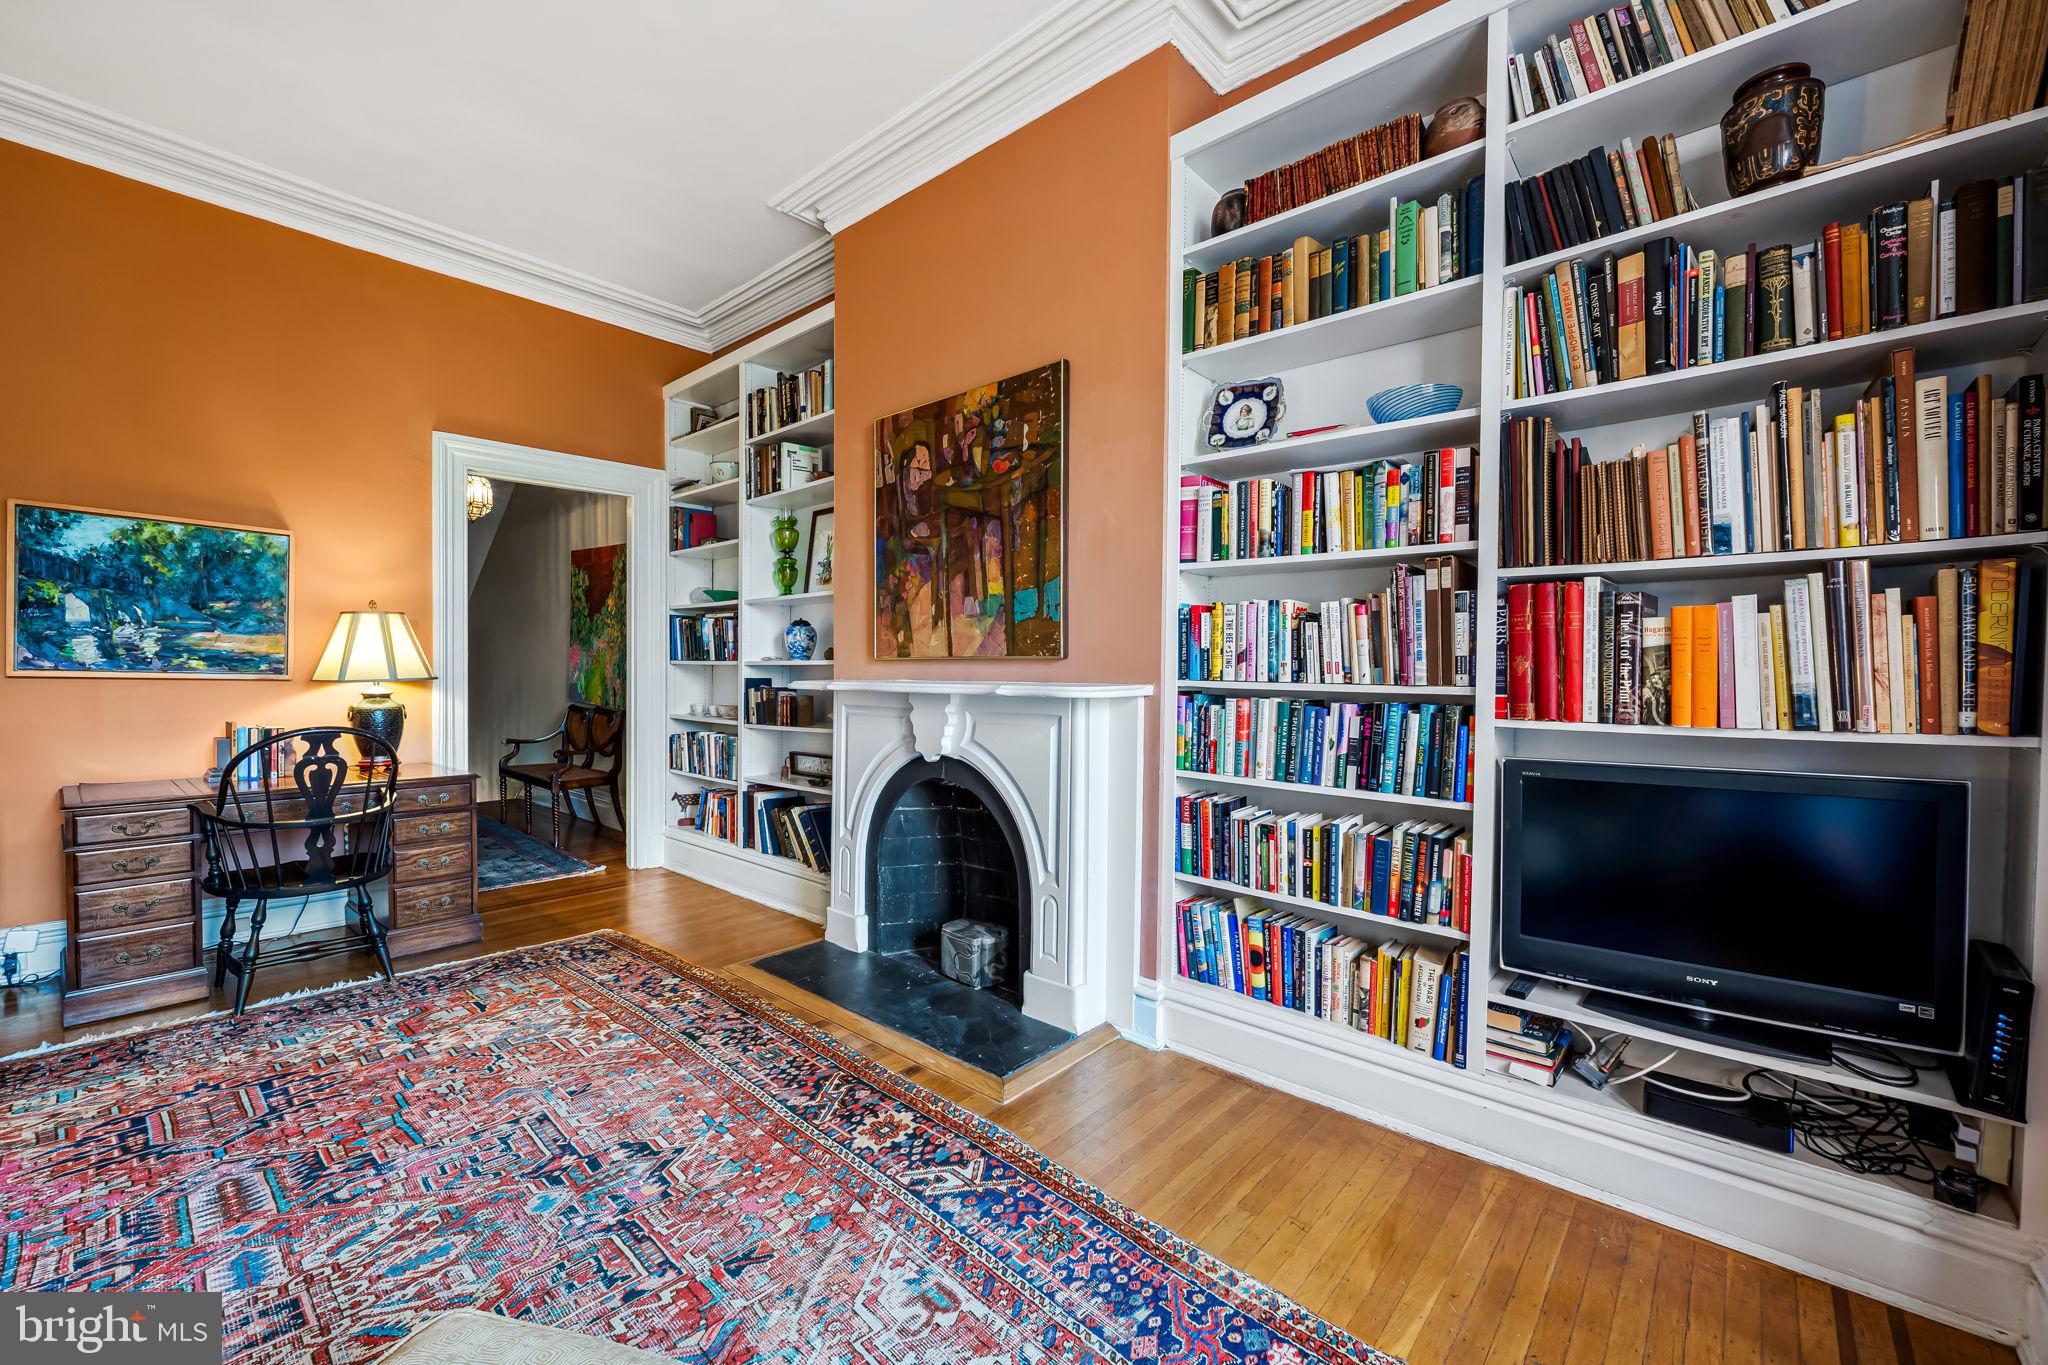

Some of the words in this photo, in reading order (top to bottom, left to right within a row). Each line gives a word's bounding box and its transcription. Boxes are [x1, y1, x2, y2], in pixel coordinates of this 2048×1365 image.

[1880, 224, 1906, 234] Charmed
[1701, 266, 1710, 295] JAPANESE
[1590, 283, 1600, 318] CHINESE
[1701, 297, 1710, 334] DECORATIVE
[1593, 322, 1602, 339] ART
[1701, 336, 1709, 347] ART
[1923, 388, 1941, 404] ART
[1696, 418, 1705, 433] SIX
[1901, 399, 1910, 438] PASCIN
[1924, 406, 1942, 441] NOUVEAU
[2024, 419, 2031, 428] OF
[2033, 444, 2041, 478] CENTURY
[1365, 474, 1374, 513] TRUST
[1655, 468, 1664, 501] VINCENT
[1657, 505, 1665, 520] VAN
[1844, 490, 1853, 519] BALTIMORE
[1658, 523, 1667, 546] GOGH
[1963, 576, 1977, 595] SIX
[1496, 610, 1507, 644] PARIS
[1619, 611, 1633, 632] The
[1620, 633, 1631, 648] Art
[1963, 604, 1977, 671] MARYLAND
[1604, 641, 1612, 656] AND
[1620, 650, 1633, 660] of
[1620, 663, 1631, 680] the
[1604, 660, 1613, 708] PRINTMAKING
[1619, 681, 1631, 702] Print
[1390, 708, 1398, 722] KATE
[1363, 716, 1372, 736] SAM
[1386, 726, 1397, 757] ATKINSON
[1385, 760, 1394, 770] BIG
[1385, 772, 1393, 784] SKY
[1405, 836, 1414, 849] KATE
[1402, 852, 1413, 881] ATKINSON
[1417, 855, 1426, 881] WINSLOW
[1414, 893, 1423, 916] BROKEN
[1686, 976, 1718, 986] SONY
[1426, 984, 1434, 1004] WARS
